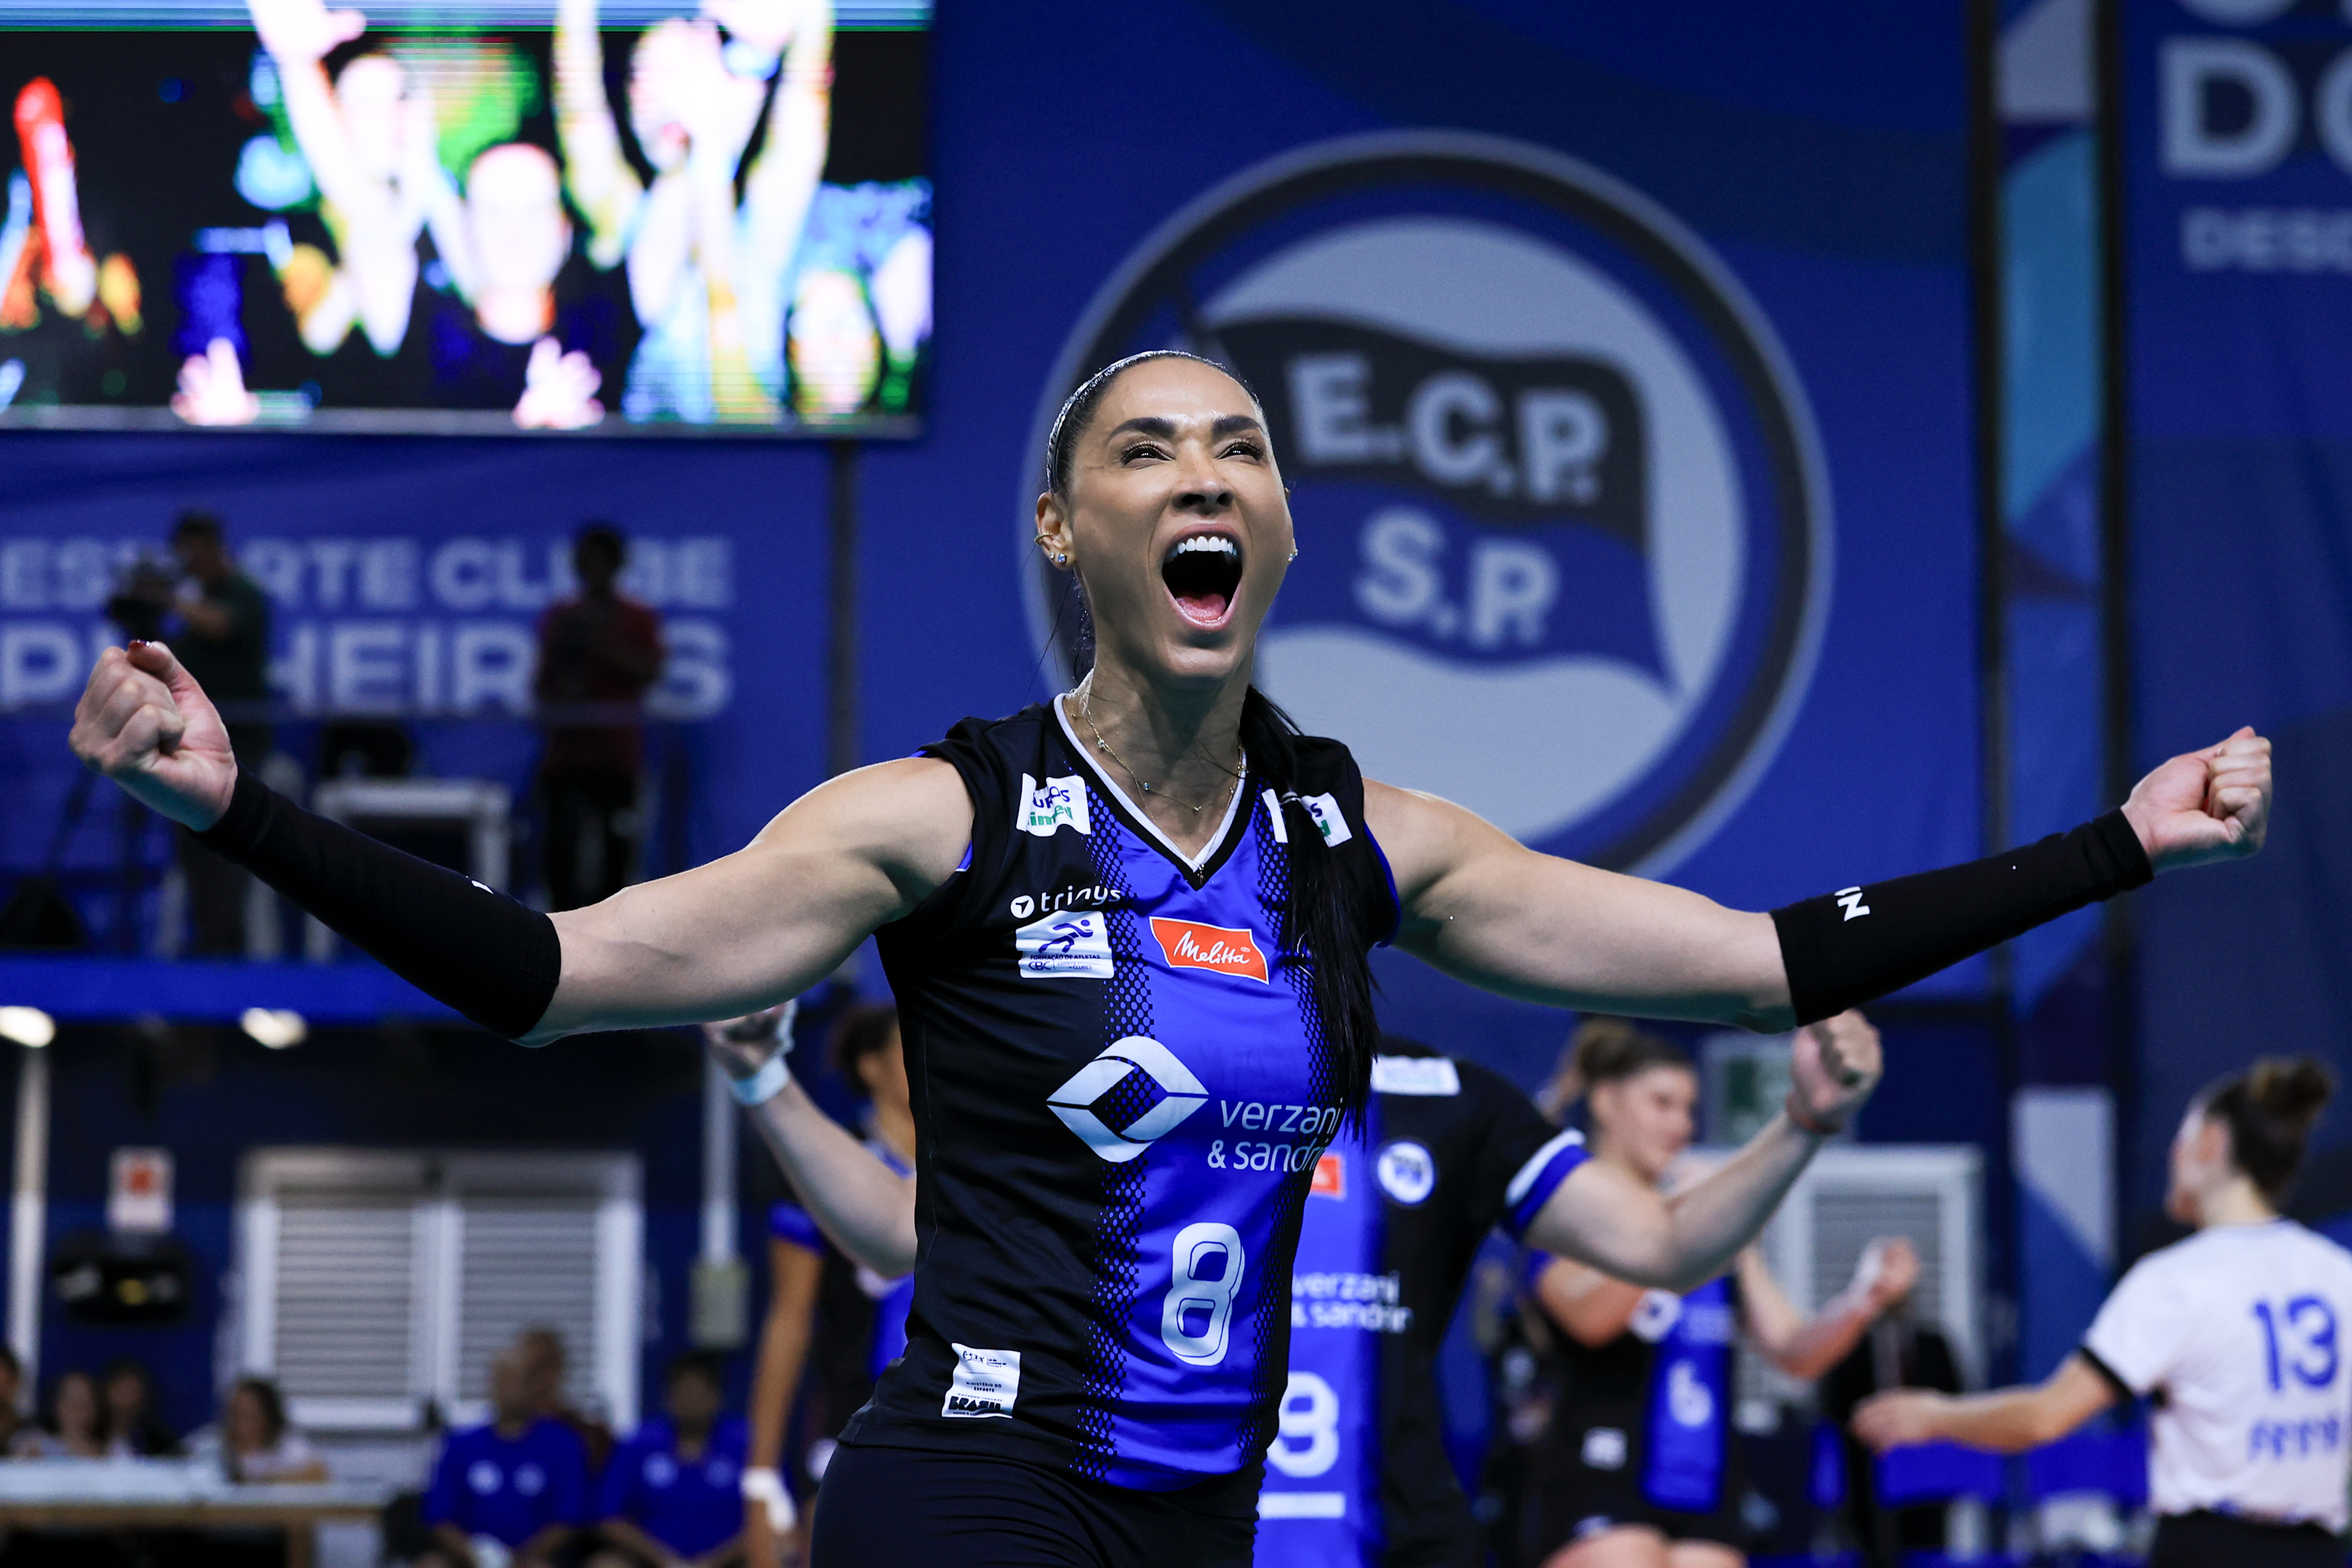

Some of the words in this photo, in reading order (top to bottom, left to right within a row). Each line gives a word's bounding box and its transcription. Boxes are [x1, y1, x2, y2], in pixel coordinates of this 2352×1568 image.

[2161, 36, 2352, 178] D
[1287, 352, 1607, 506] E.C.P.
[2, 537, 413, 608] ESRTE
[0, 622, 731, 717] PHEIRS
[1028, 961, 1051, 971] CBC
[1173, 930, 1250, 964] Melitta
[1207, 1139, 1226, 1169] &
[1233, 1138, 1330, 1173] sandri
[1220, 1097, 1343, 1134] verzani
[1161, 1222, 1245, 1367] 8
[2252, 1297, 2339, 1392] 13
